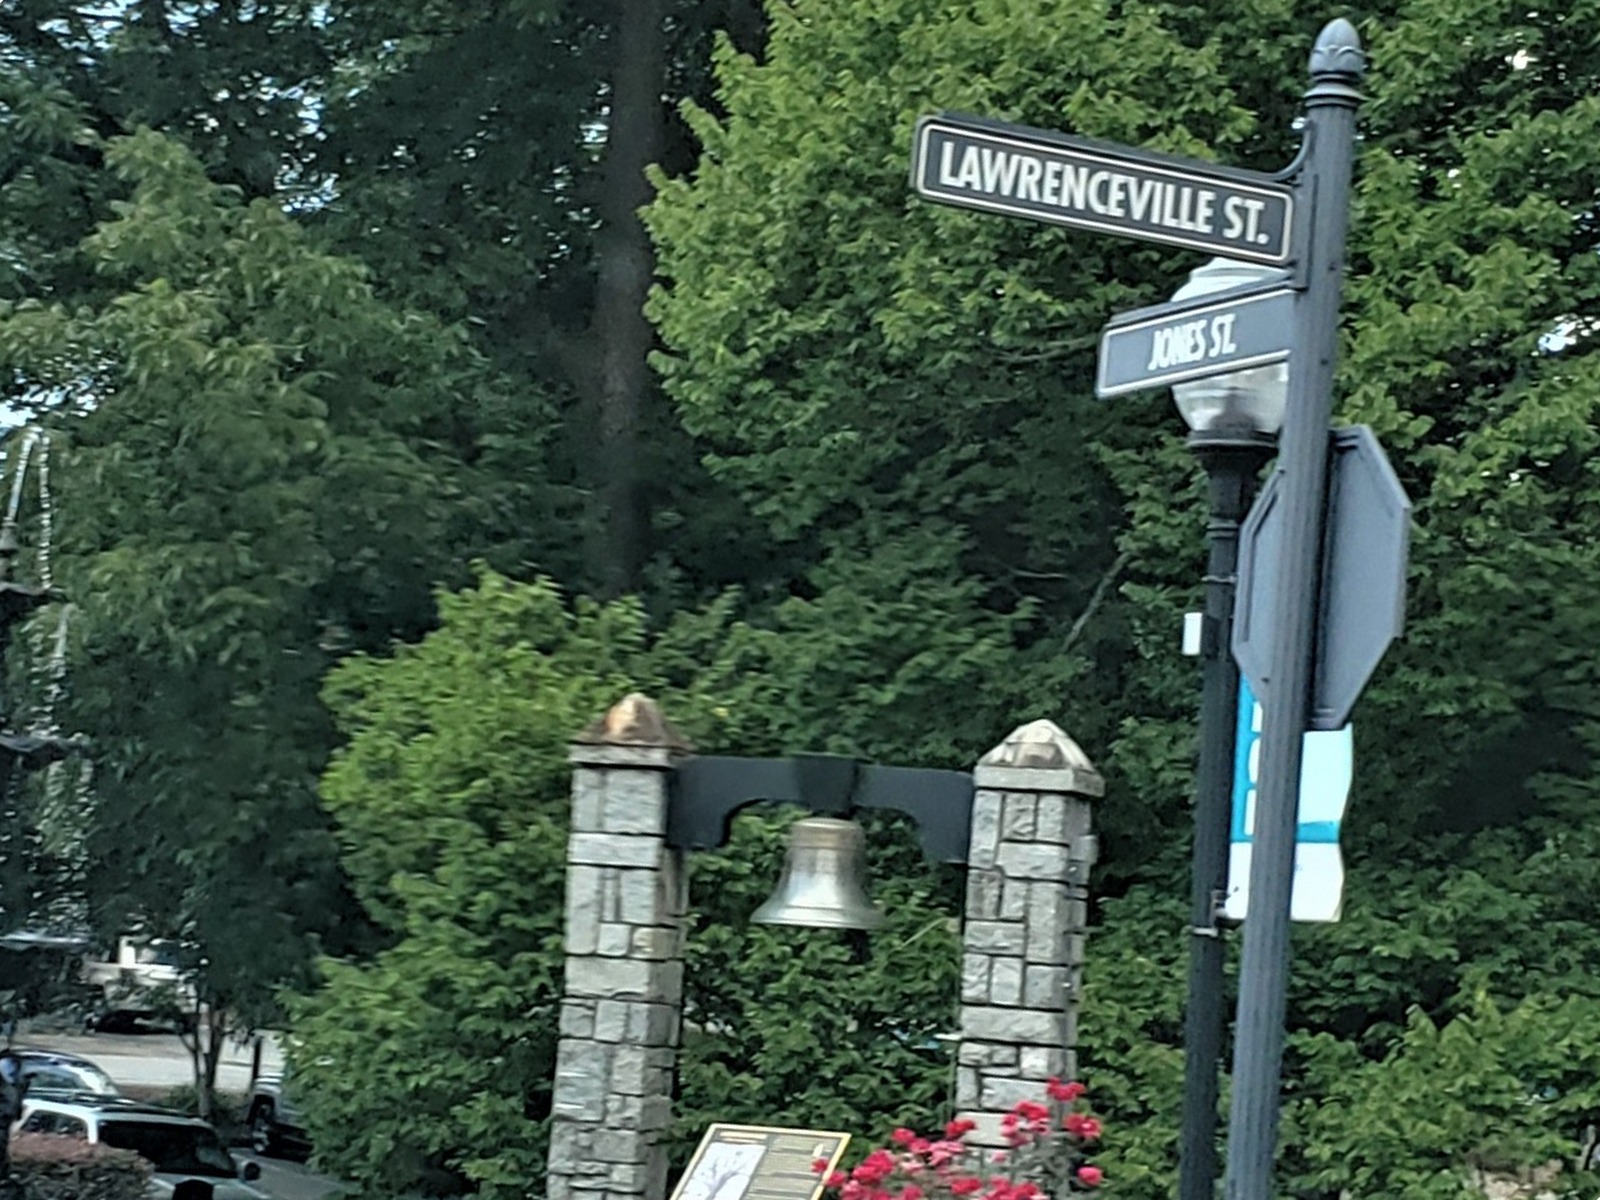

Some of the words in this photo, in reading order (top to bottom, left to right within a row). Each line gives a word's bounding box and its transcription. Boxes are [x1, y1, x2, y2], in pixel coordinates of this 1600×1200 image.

[940, 141, 1216, 233] LAWRENCEVILLE
[1222, 195, 1270, 245] ST.
[1148, 319, 1206, 371] JONES
[1208, 314, 1237, 357] ST.
